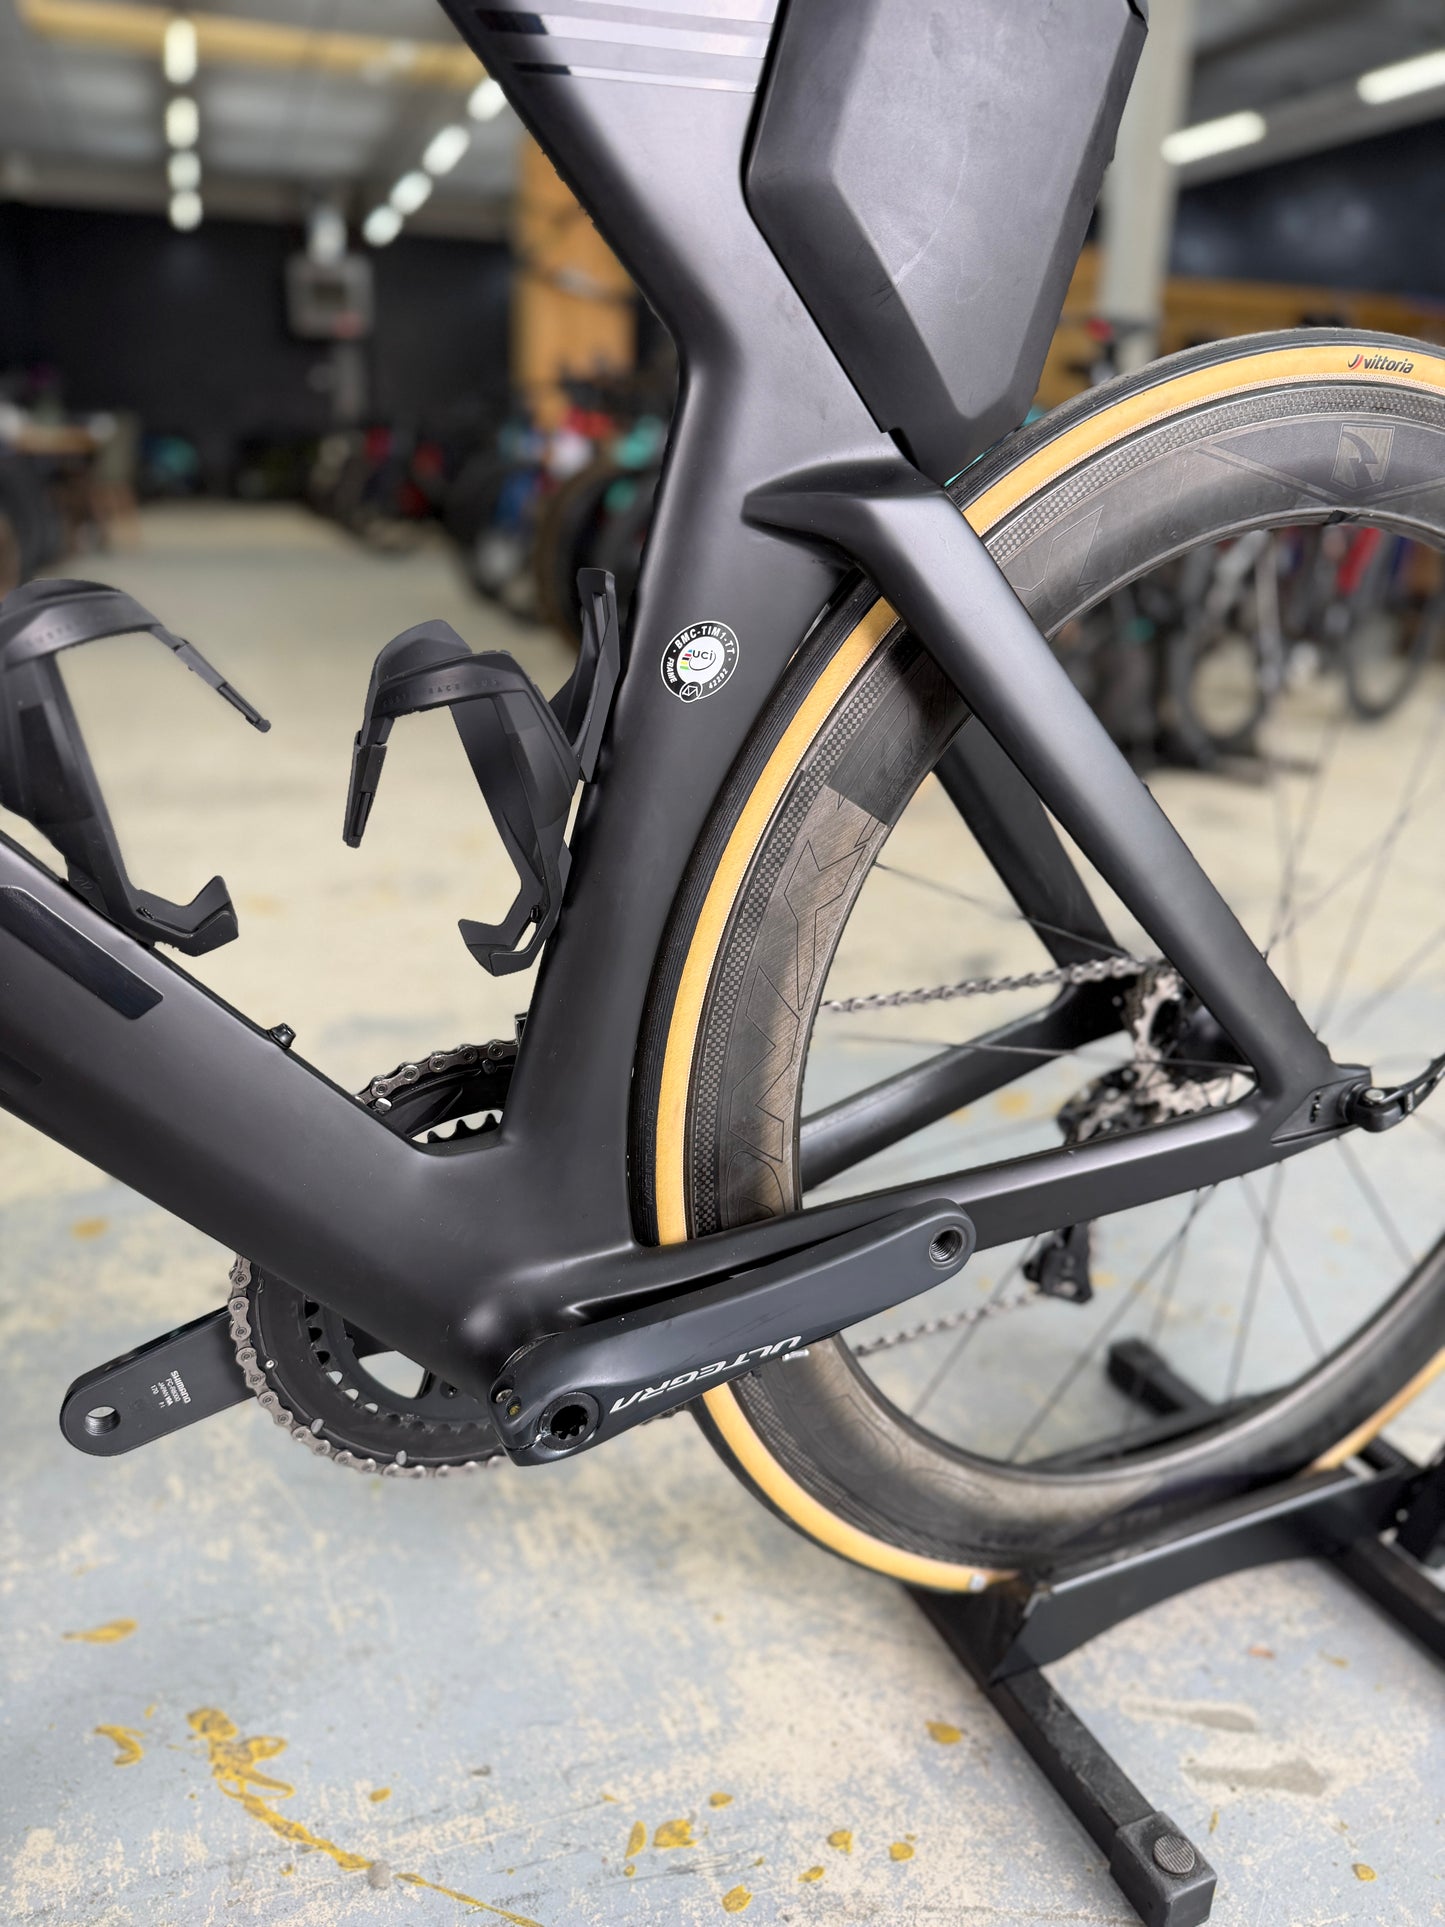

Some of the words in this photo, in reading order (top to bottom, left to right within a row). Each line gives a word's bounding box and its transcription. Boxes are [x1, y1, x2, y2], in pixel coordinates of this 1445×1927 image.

[1363, 354, 1414, 374] vittoria
[674, 626, 736, 655] BMC-TIM1-TT
[666, 657, 678, 684] FRAME
[170, 1370, 191, 1404] SHIMANO
[609, 1335, 802, 1414] ULTEGRA
